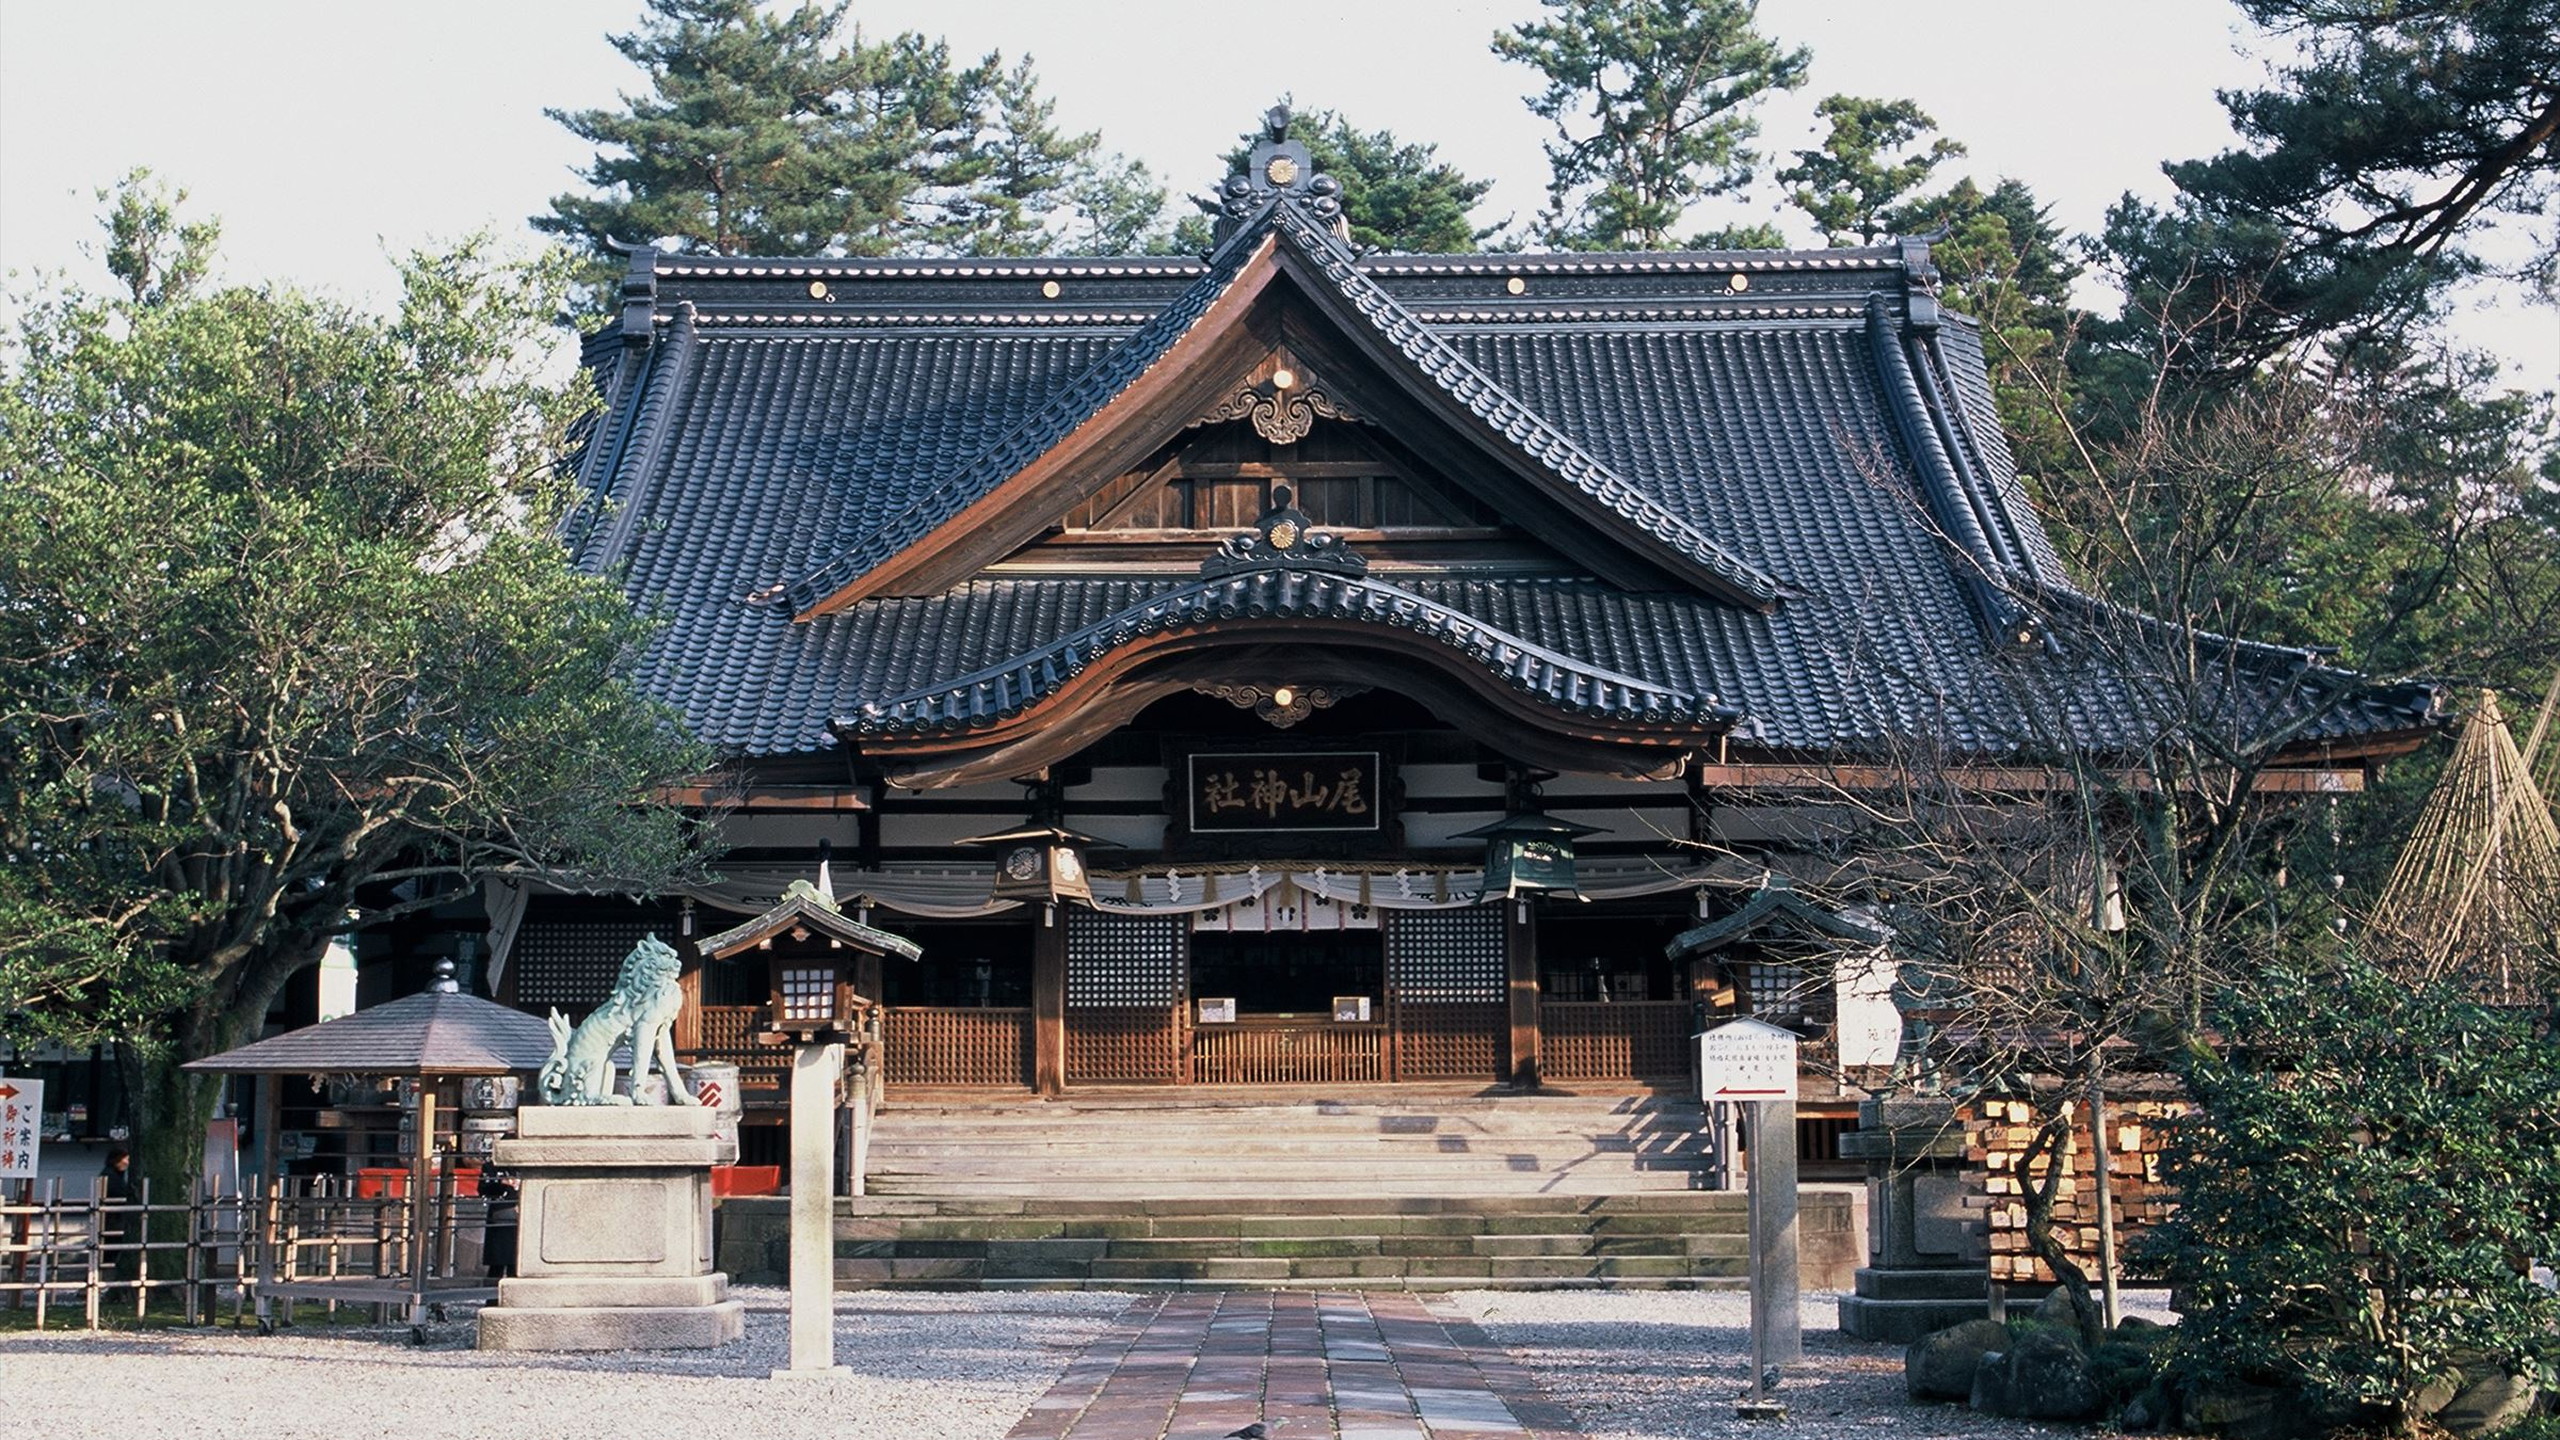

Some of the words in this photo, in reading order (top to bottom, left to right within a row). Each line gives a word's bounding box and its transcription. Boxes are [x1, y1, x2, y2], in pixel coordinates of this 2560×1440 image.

[1204, 768, 1368, 818] 尾山神社
[18, 1104, 33, 1170] ご案内
